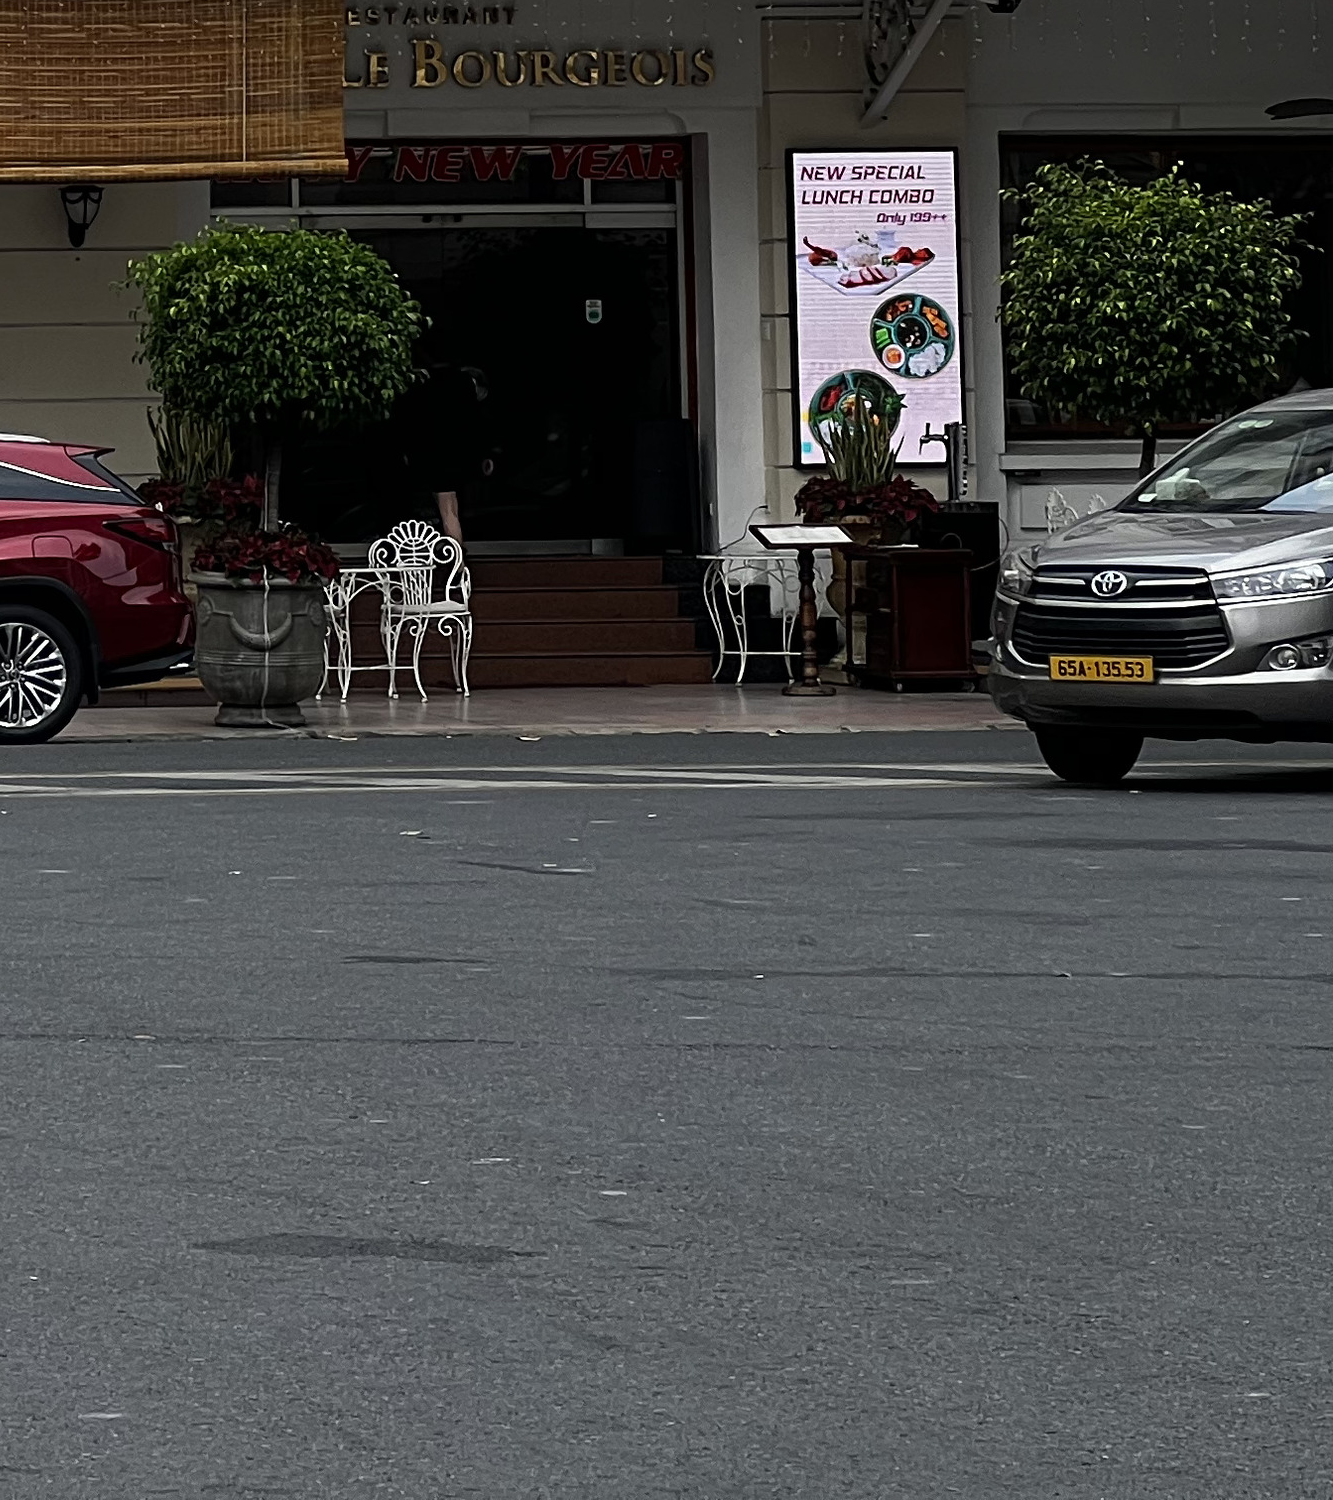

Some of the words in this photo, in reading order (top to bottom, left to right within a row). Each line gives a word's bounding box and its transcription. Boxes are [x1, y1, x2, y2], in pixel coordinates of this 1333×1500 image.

[346, 6, 517, 27] ESTAURANT
[393, 145, 522, 183] NEW
[548, 142, 685, 180] YEAR
[800, 166, 846, 181] NEW
[851, 165, 926, 180] SPECIAL
[801, 190, 863, 204] LUNCH
[868, 189, 935, 204] COMBO
[876, 212, 906, 226] Only
